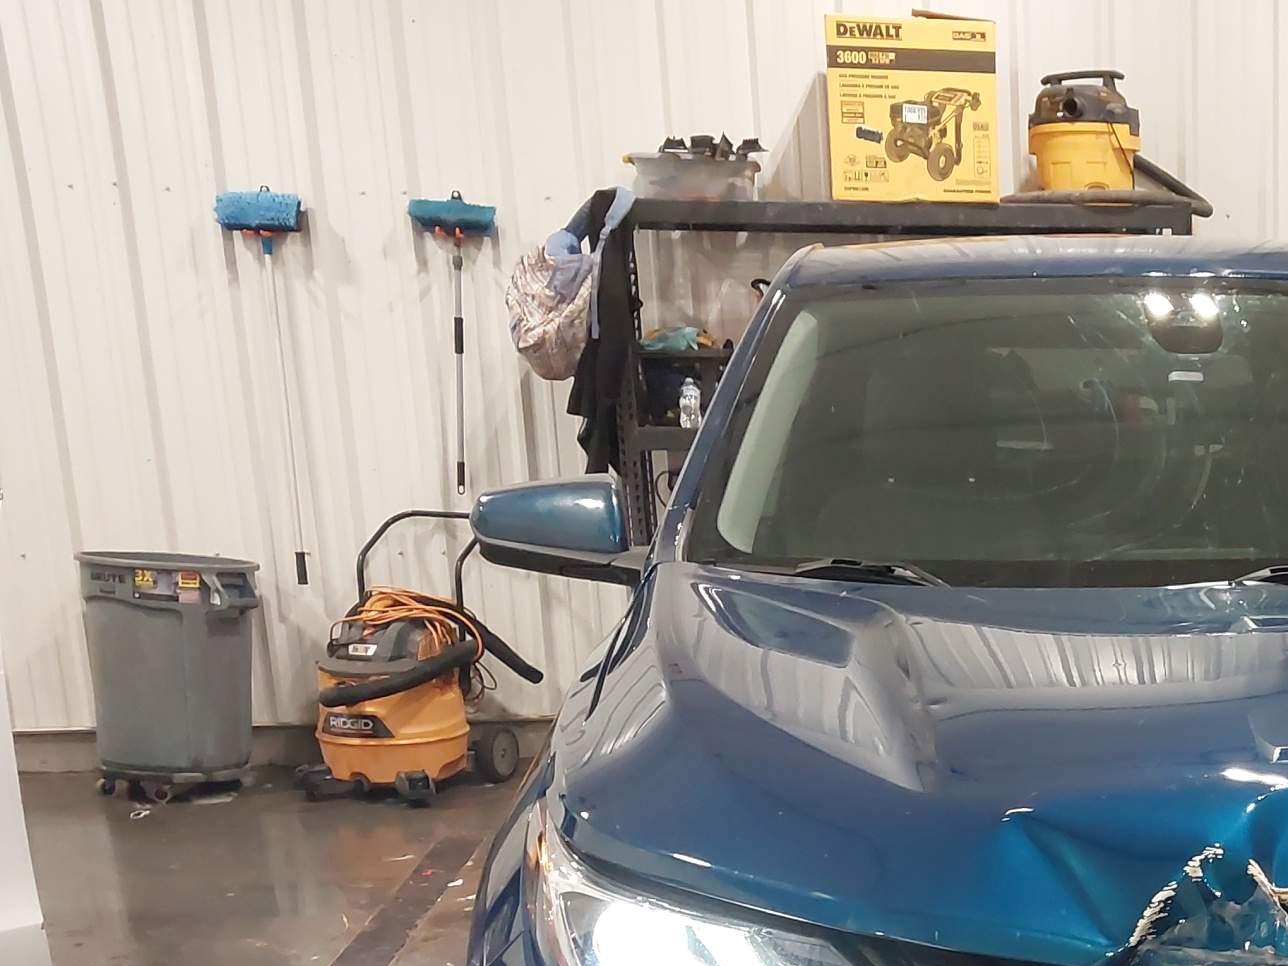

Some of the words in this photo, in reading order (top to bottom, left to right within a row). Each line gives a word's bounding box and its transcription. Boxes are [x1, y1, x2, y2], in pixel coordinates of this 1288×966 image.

[836, 51, 866, 65] 3600
[135, 569, 153, 582] 3X
[329, 716, 374, 730] RIDGID
